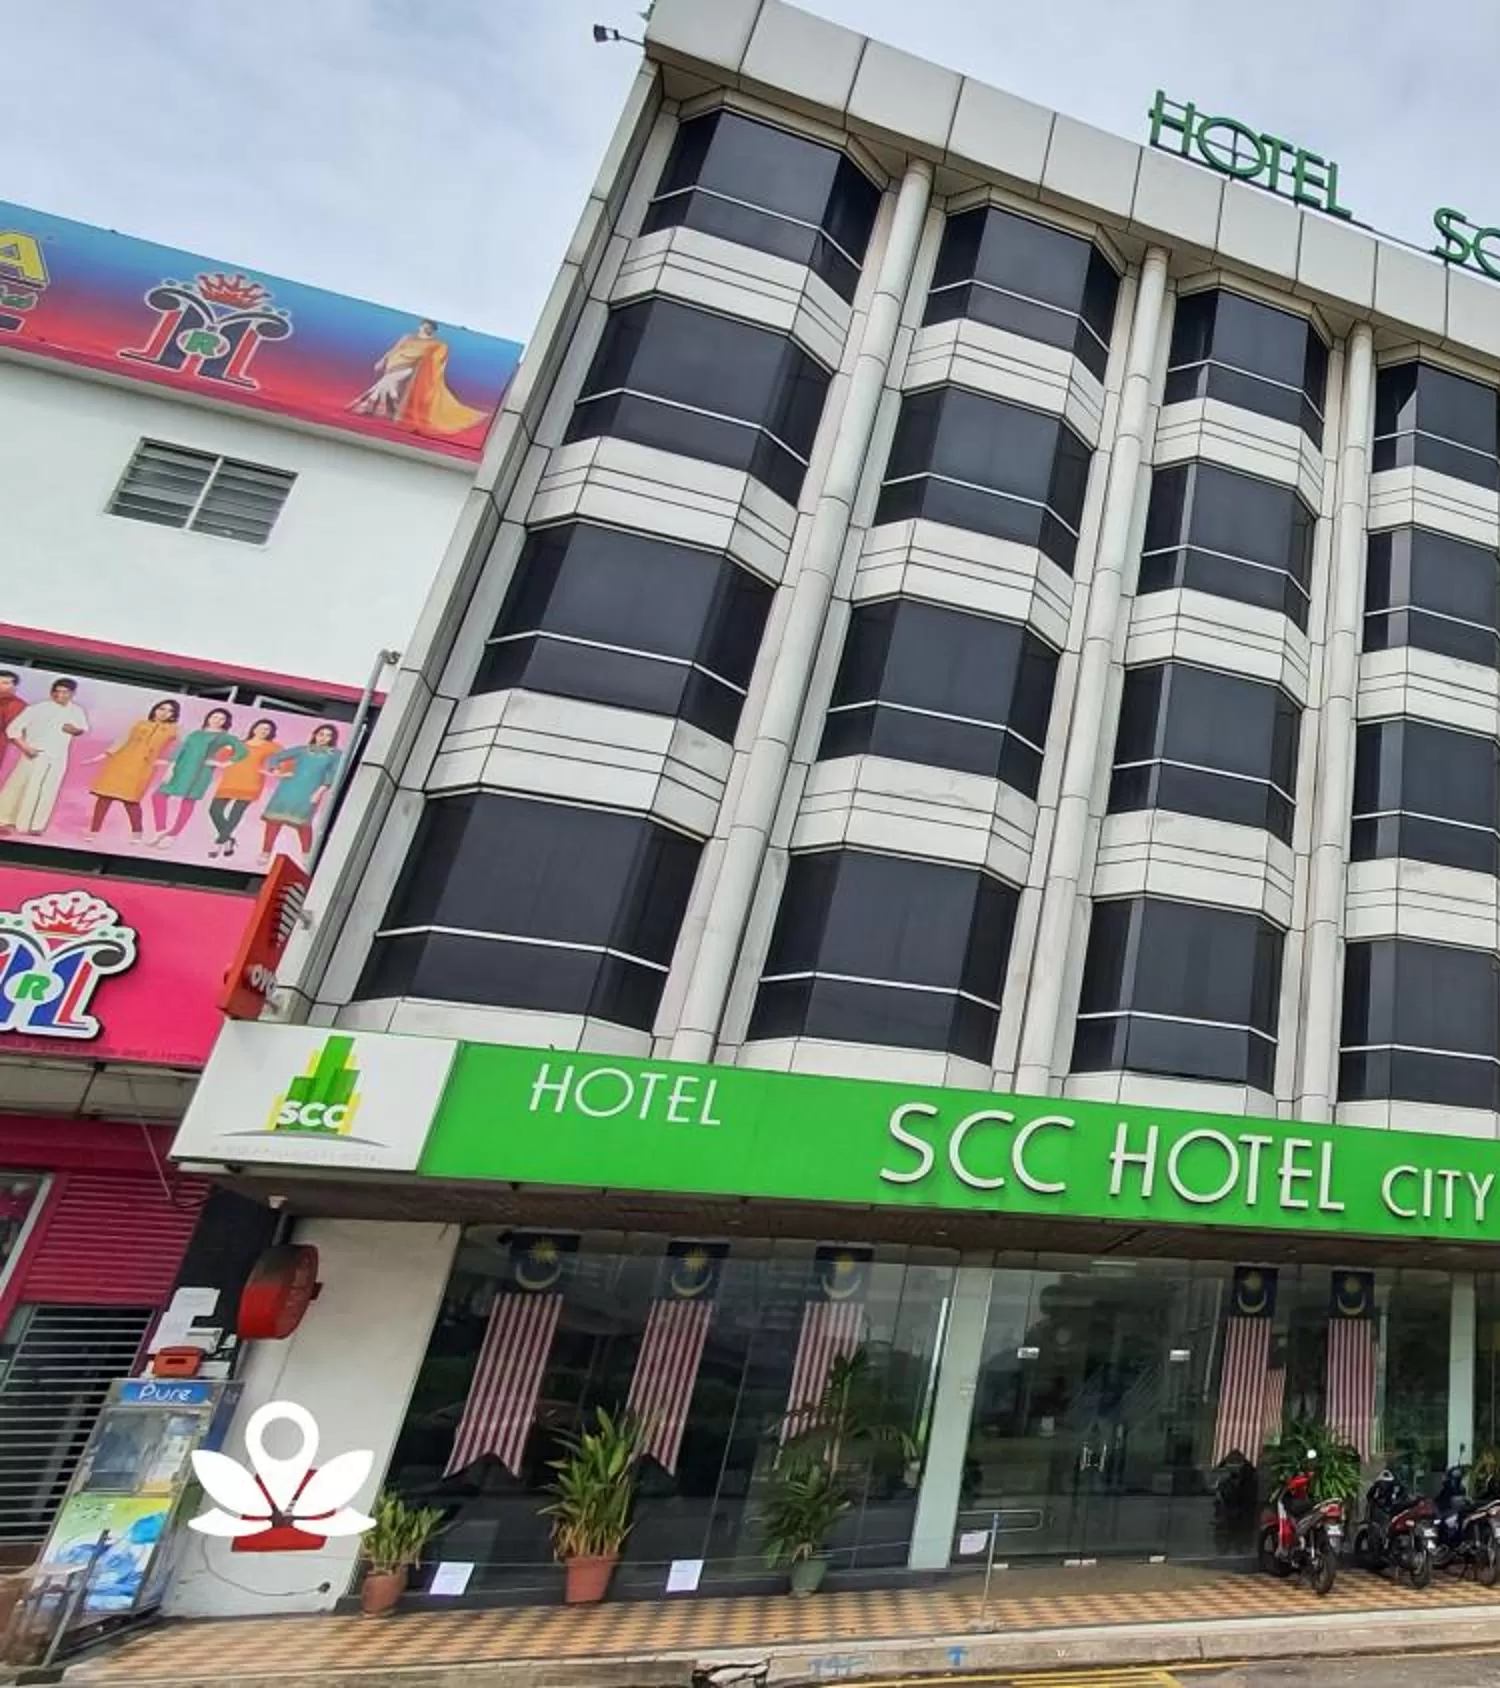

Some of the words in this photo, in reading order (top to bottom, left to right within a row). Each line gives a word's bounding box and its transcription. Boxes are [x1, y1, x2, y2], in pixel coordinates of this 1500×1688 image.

[1148, 89, 1351, 219] HOTEL
[275, 1101, 348, 1128] SCC
[529, 1063, 722, 1126] HOTEL
[879, 1102, 1076, 1194] SCC
[1109, 1122, 1346, 1212] HOTEL
[1381, 1165, 1495, 1222] CITY
[139, 1382, 192, 1402] Pure
